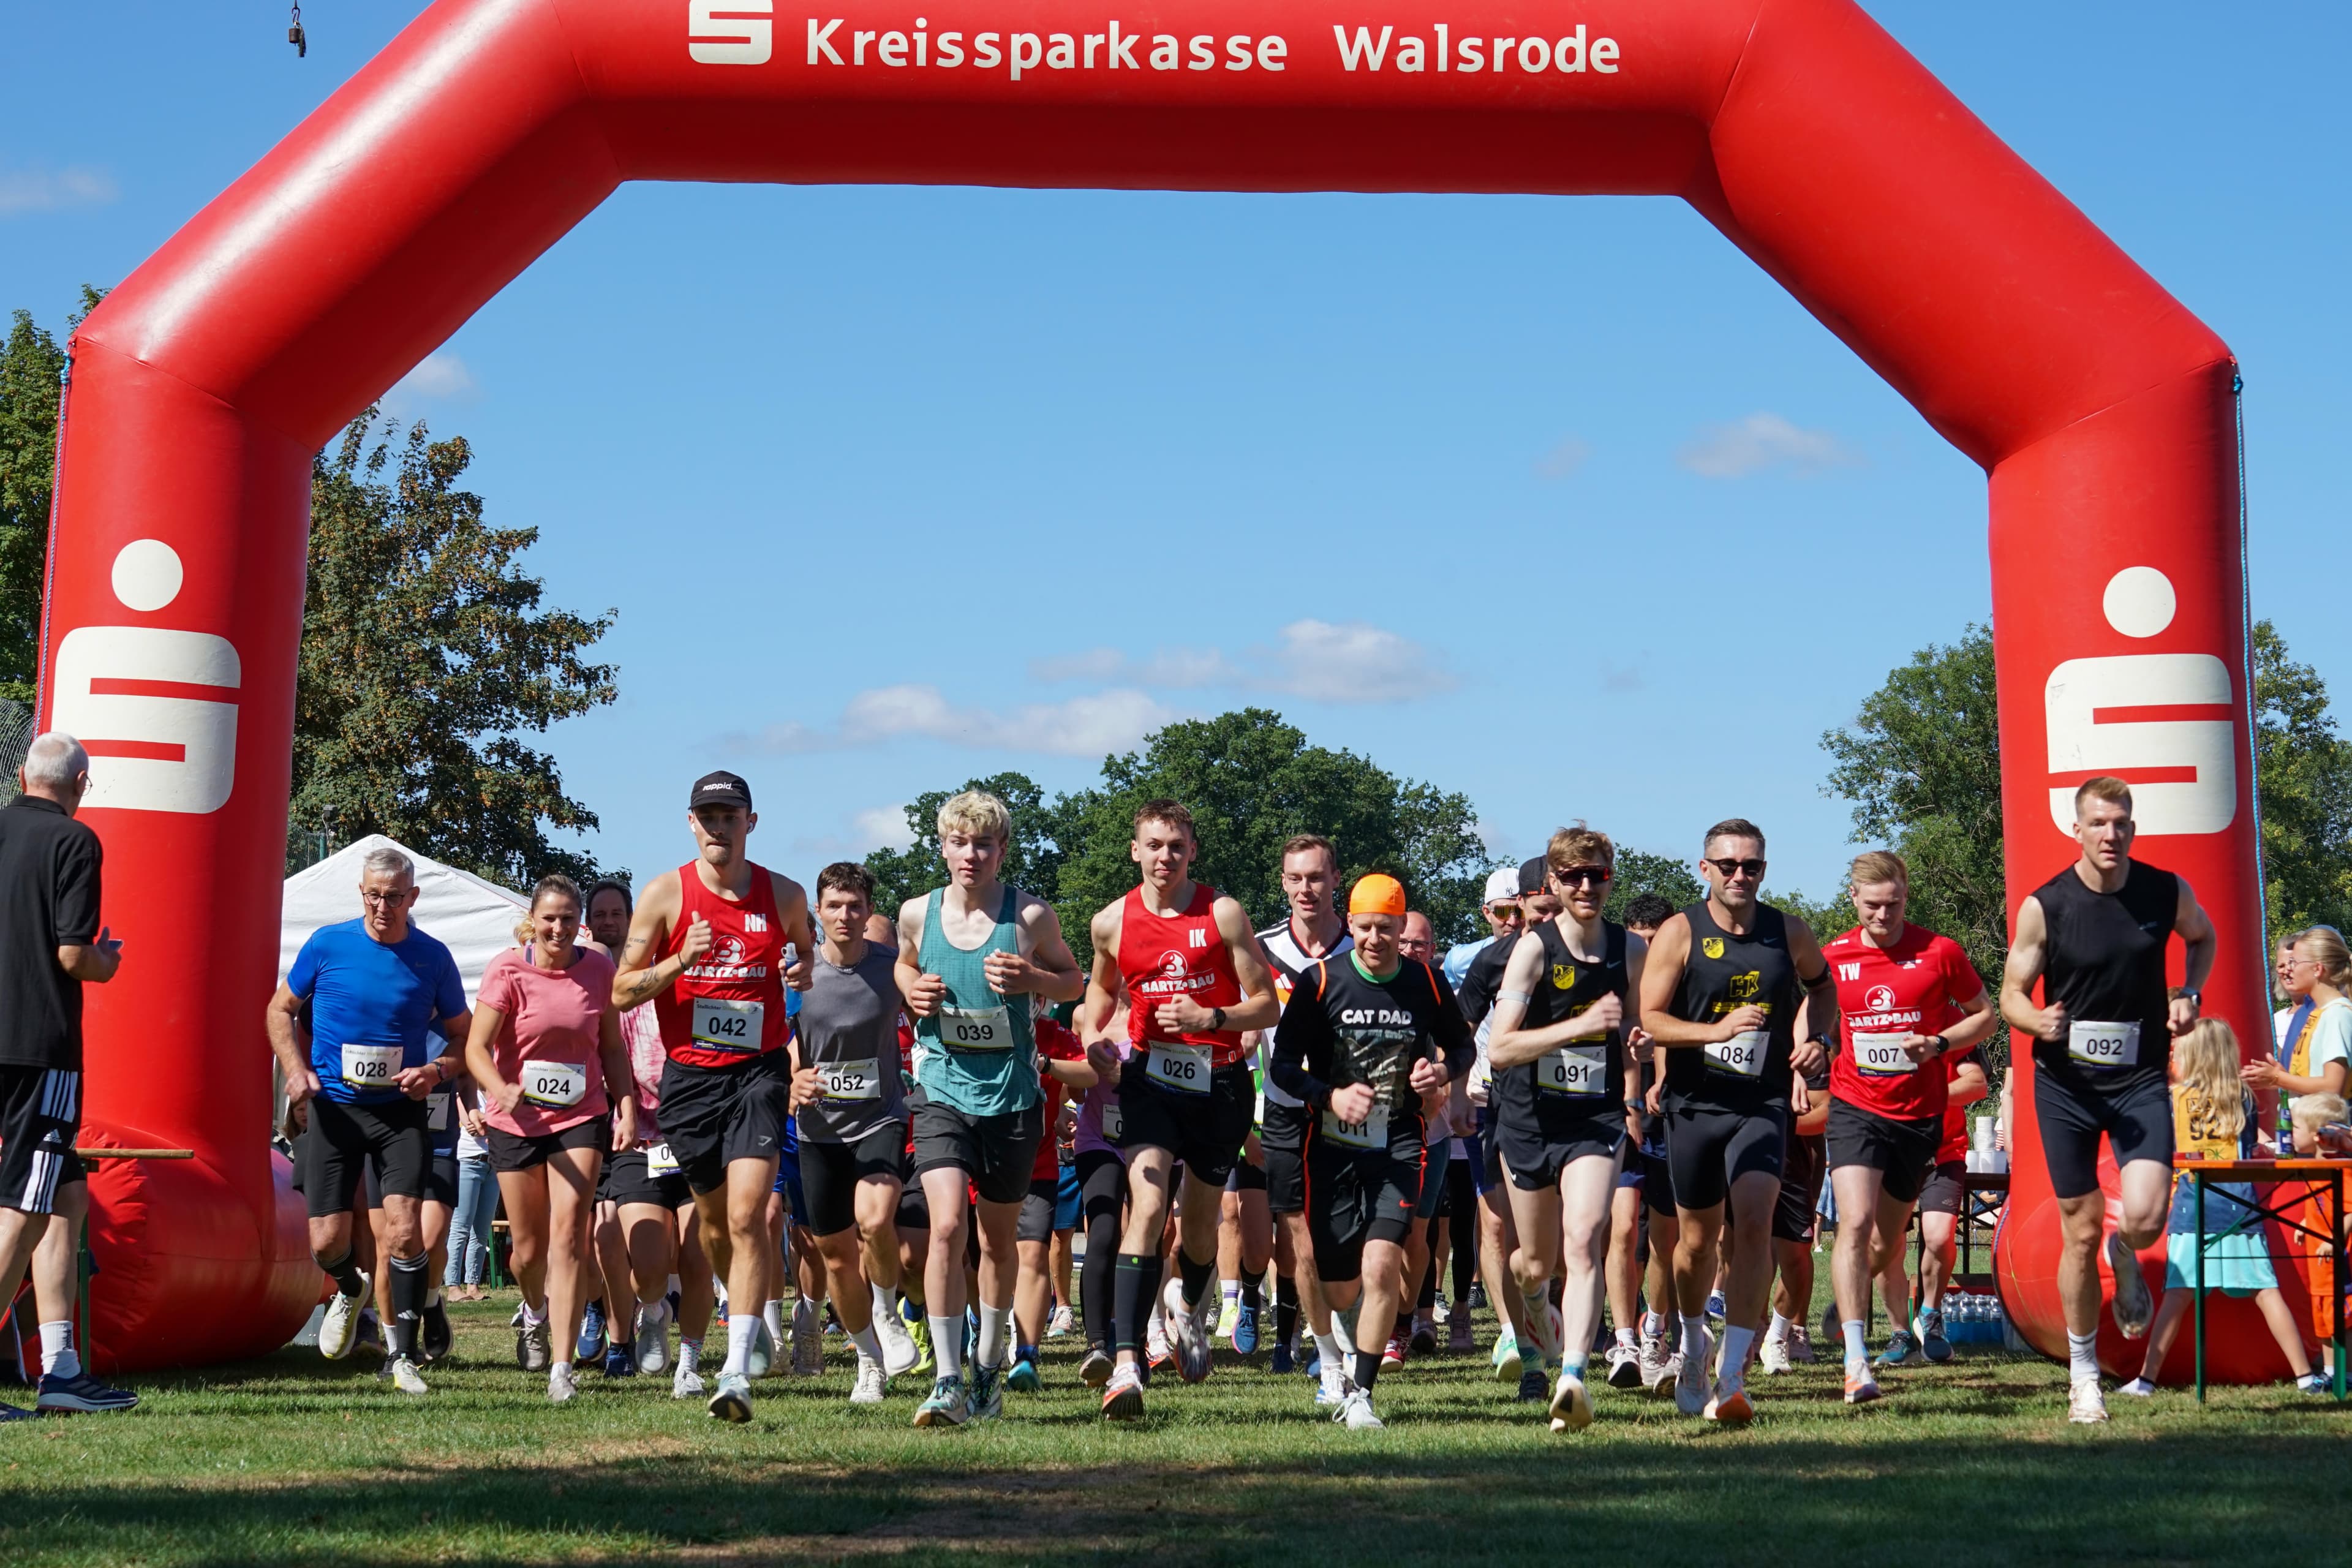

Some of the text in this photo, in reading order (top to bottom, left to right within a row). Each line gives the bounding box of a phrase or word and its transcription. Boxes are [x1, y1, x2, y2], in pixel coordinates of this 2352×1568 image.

[807, 17, 1620, 81] Kreissparkasse Walsrode
[745, 913, 767, 932] NH
[1189, 929, 1207, 948] IK
[1838, 962, 1860, 981] YW
[1341, 1009, 1412, 1025] CAT DAD
[709, 1017, 746, 1037] 042
[957, 1025, 993, 1041] 039
[1721, 1046, 1755, 1065] 084
[1868, 1048, 1899, 1063] 007
[2087, 1039, 2123, 1055] 092
[355, 1061, 387, 1077] 028
[1163, 1058, 1196, 1080] 026
[1555, 1065, 1588, 1083] 091
[537, 1077, 571, 1095] 024
[831, 1074, 865, 1092] 052
